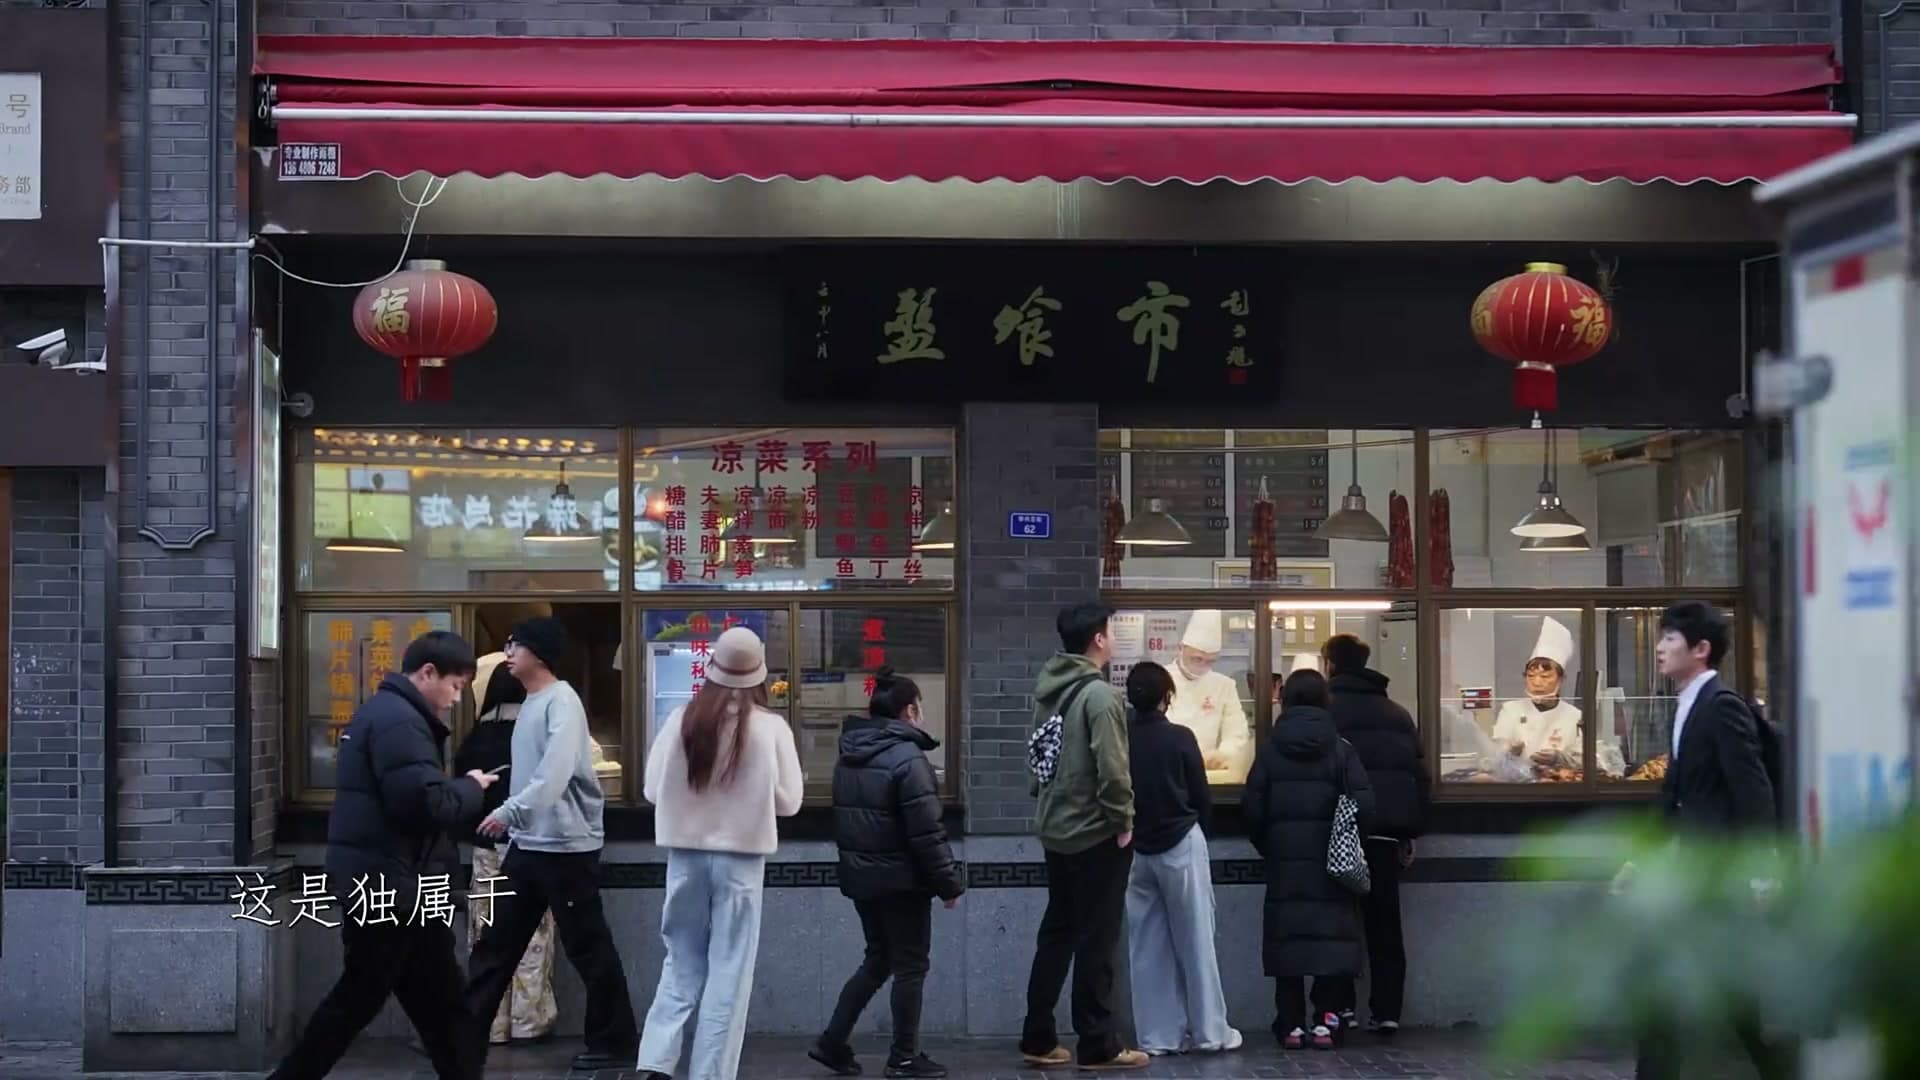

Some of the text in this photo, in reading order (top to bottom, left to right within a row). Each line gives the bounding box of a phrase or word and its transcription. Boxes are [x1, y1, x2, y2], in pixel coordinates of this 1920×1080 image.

[6, 94, 31, 118] 号
[370, 287, 411, 334] 福
[1569, 294, 1607, 346] 福
[712, 440, 877, 475] 凉菜系列
[768, 484, 788, 530] 凉面
[1024, 524, 1037, 534] 62
[665, 484, 687, 583] 糖醋排骨
[700, 484, 720, 580] 夫妻肺片
